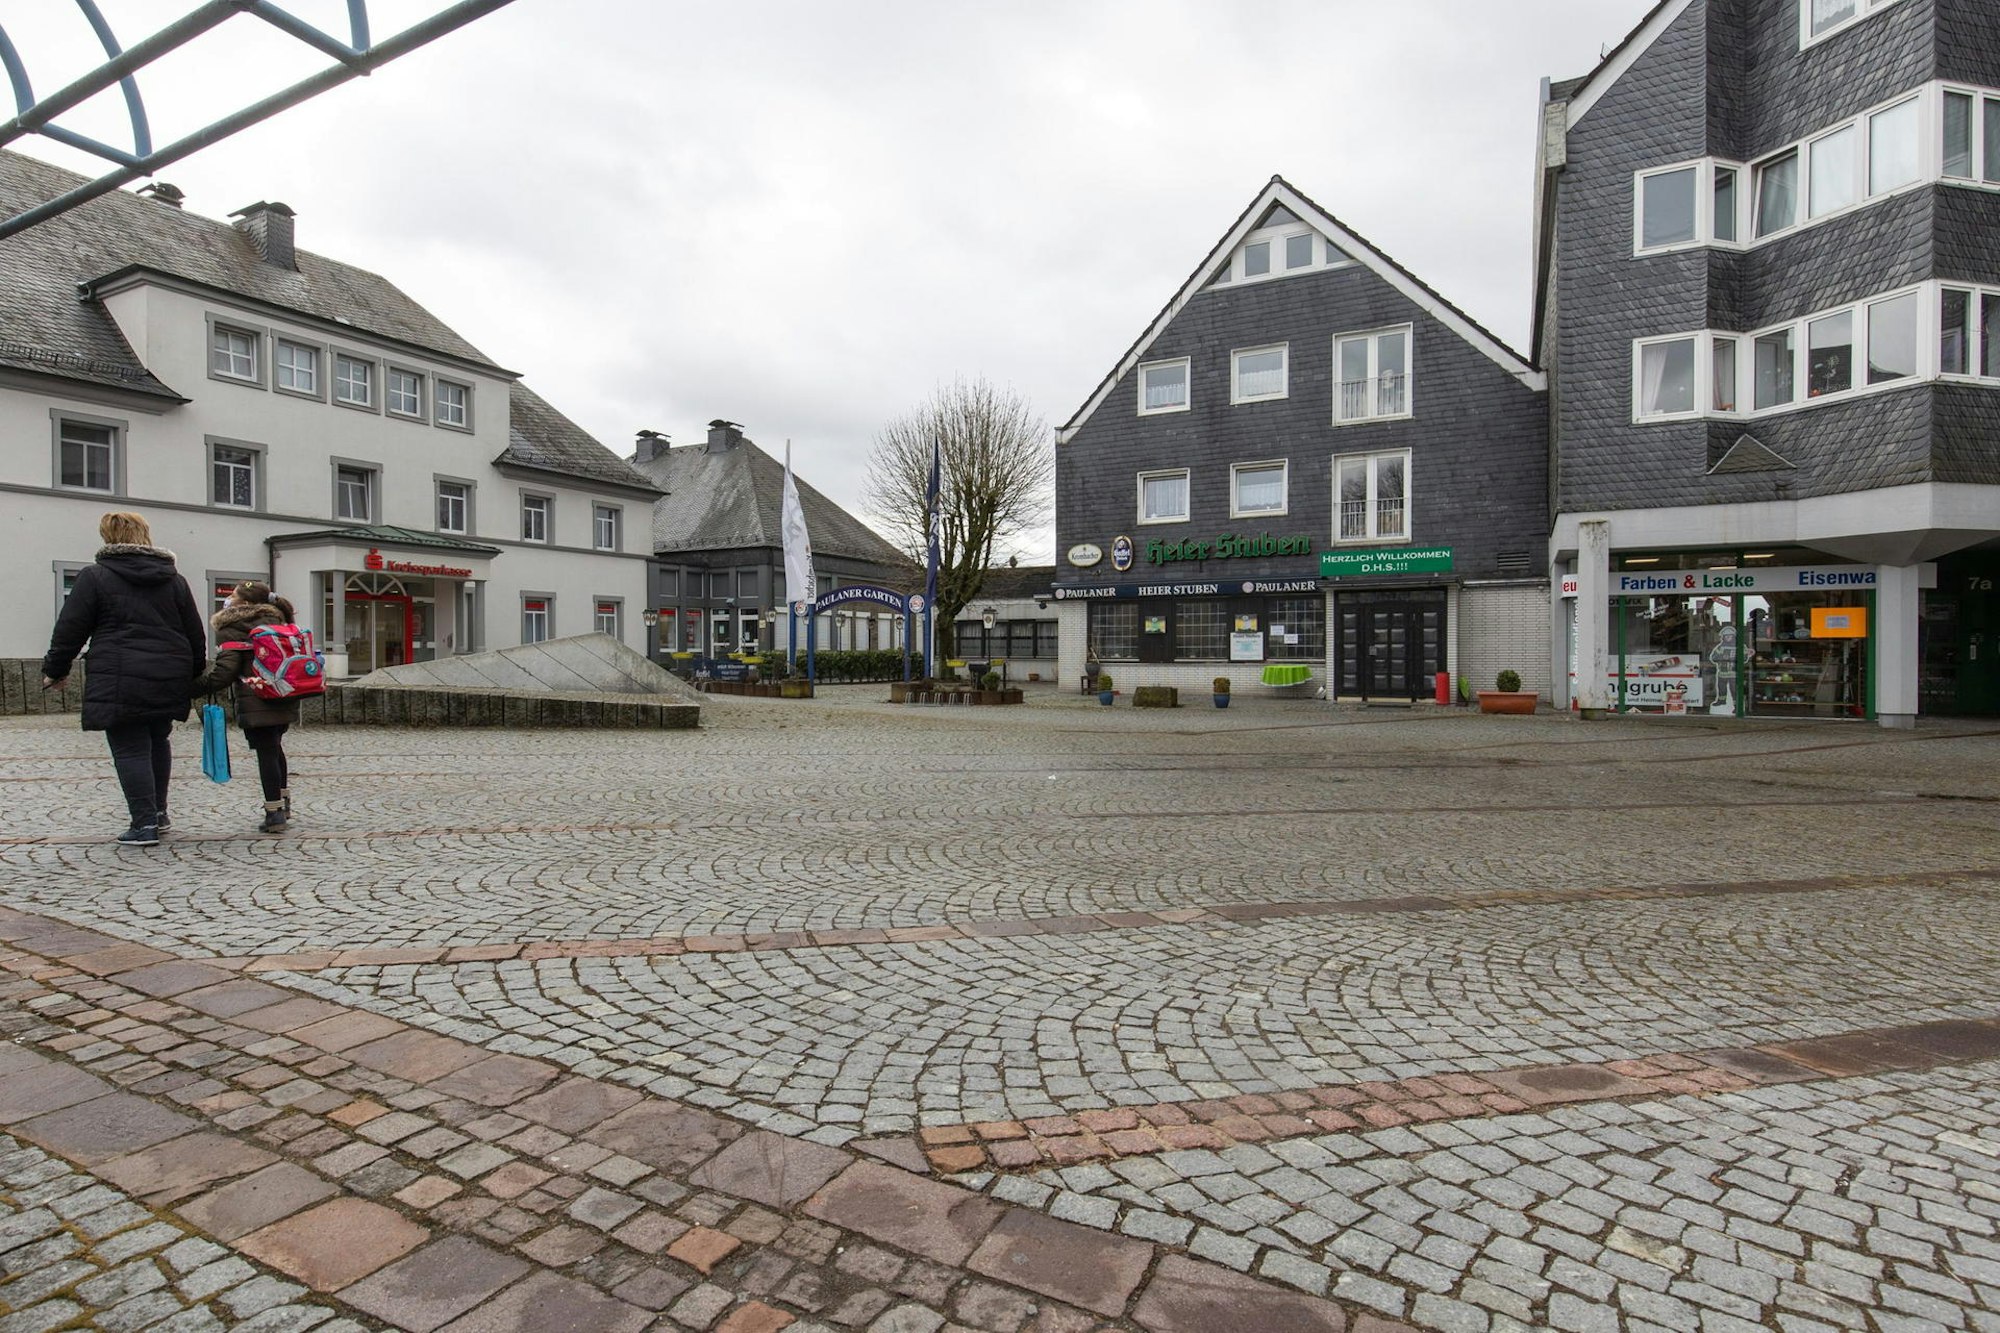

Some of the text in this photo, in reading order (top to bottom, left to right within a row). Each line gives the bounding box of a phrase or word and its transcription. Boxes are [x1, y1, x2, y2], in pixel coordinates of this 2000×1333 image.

[1146, 531, 1312, 566] Heier Stuben
[1322, 551, 1450, 563] HERZLICH WILLKOMMEN
[1361, 563, 1408, 573] D.H.S.!!!
[1621, 573, 1755, 590] Farben & Lacke
[1799, 571, 1876, 585] Eisenwa
[1968, 577, 1992, 590] 7a
[1066, 580, 1315, 598] PAULANER HEIER STUBEN PAULANER
[815, 588, 902, 610] PAULANER GARTEN
